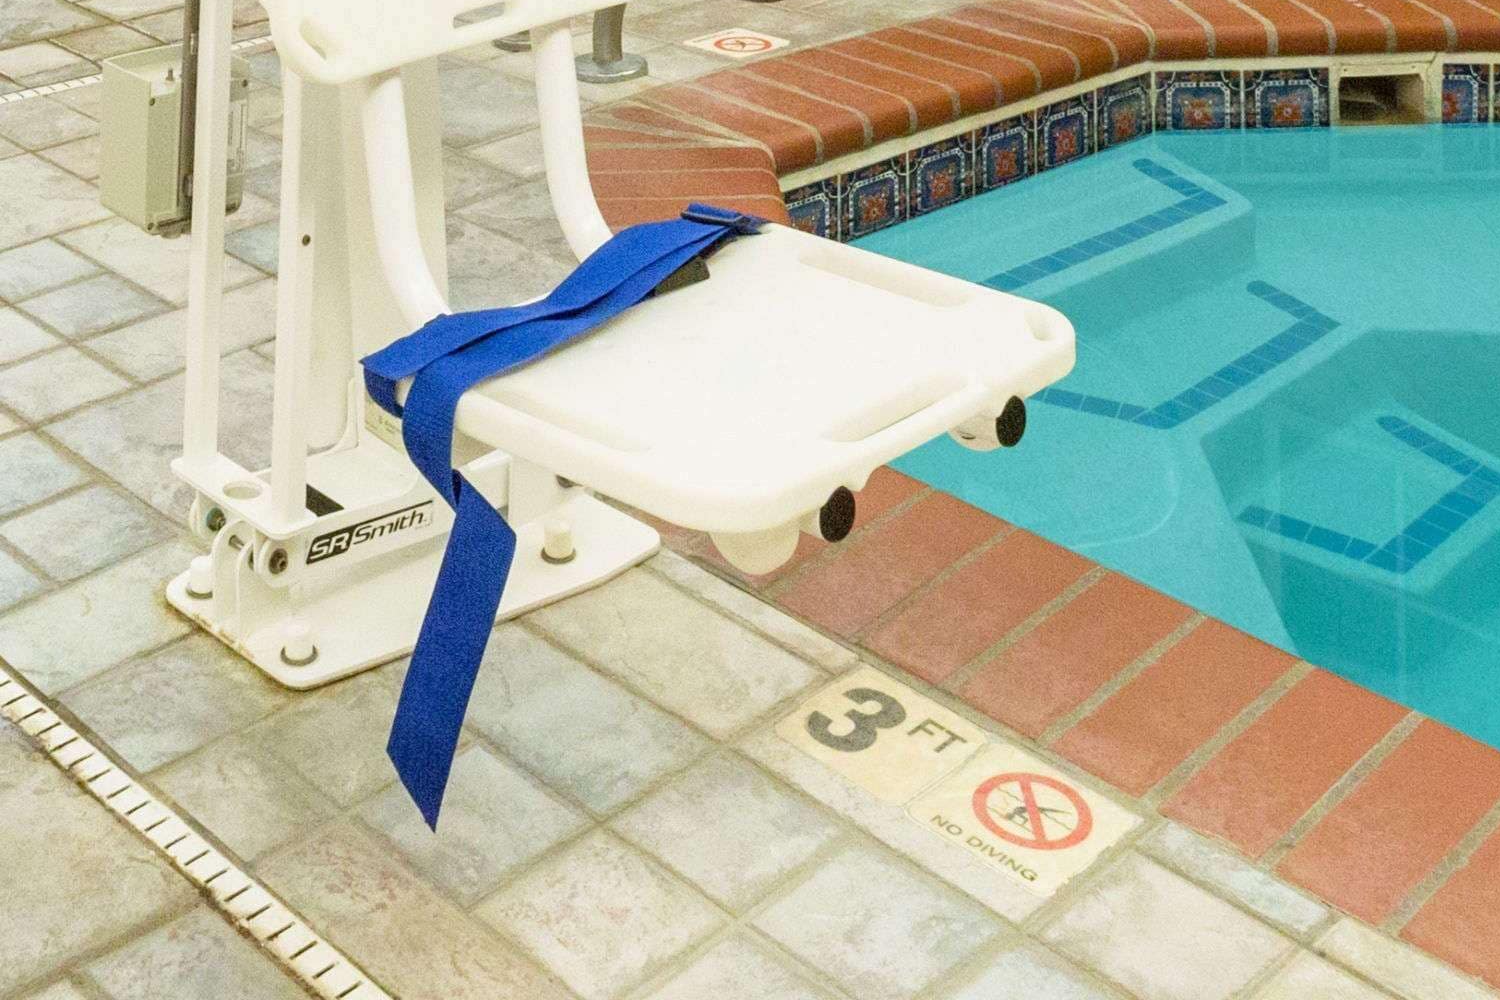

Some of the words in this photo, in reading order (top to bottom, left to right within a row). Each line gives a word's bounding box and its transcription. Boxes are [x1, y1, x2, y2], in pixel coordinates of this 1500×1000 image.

[352, 510, 424, 545] Smith
[808, 688, 907, 752] 3
[907, 717, 967, 753] FT
[930, 814, 962, 836] NO
[965, 836, 1038, 882] DIVING
